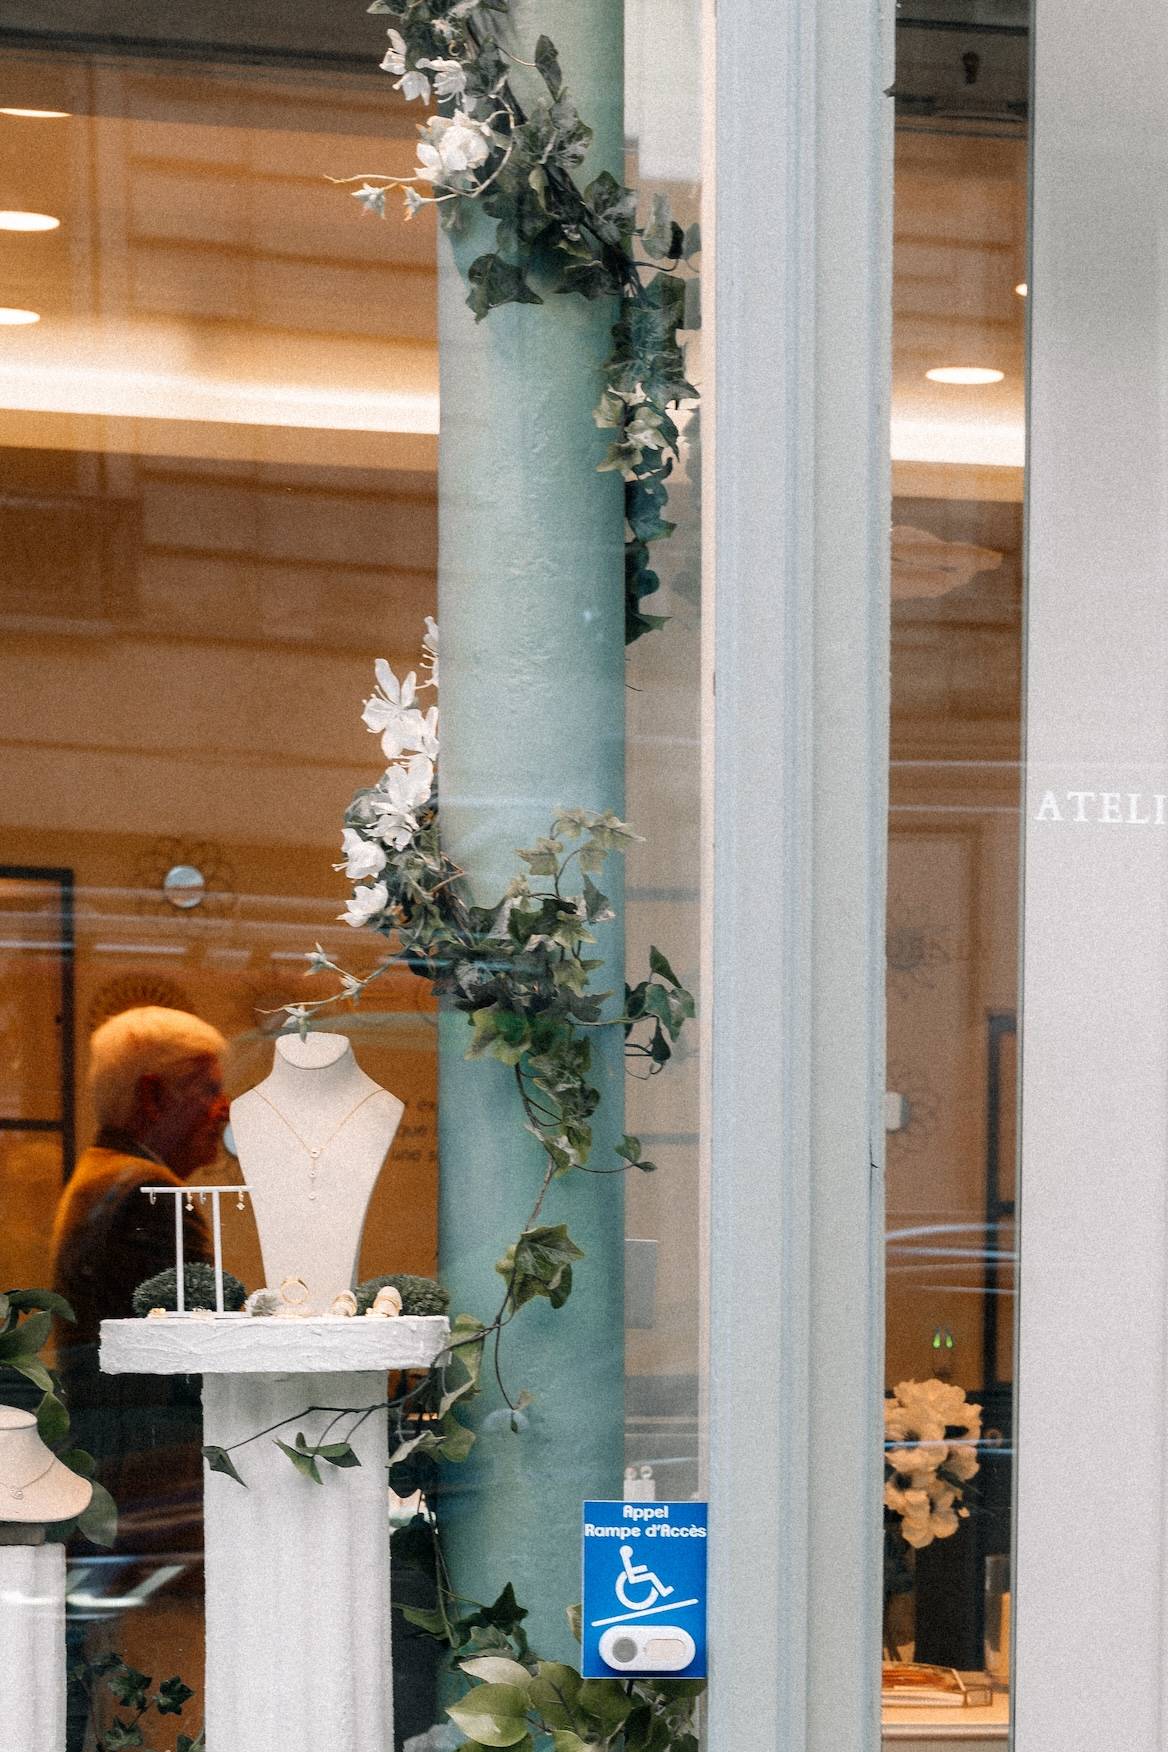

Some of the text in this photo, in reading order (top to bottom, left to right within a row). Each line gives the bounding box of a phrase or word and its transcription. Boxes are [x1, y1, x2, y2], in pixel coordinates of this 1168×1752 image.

[623, 1504, 669, 1522] Appel
[584, 1523, 708, 1541] Rampe d'Accès
